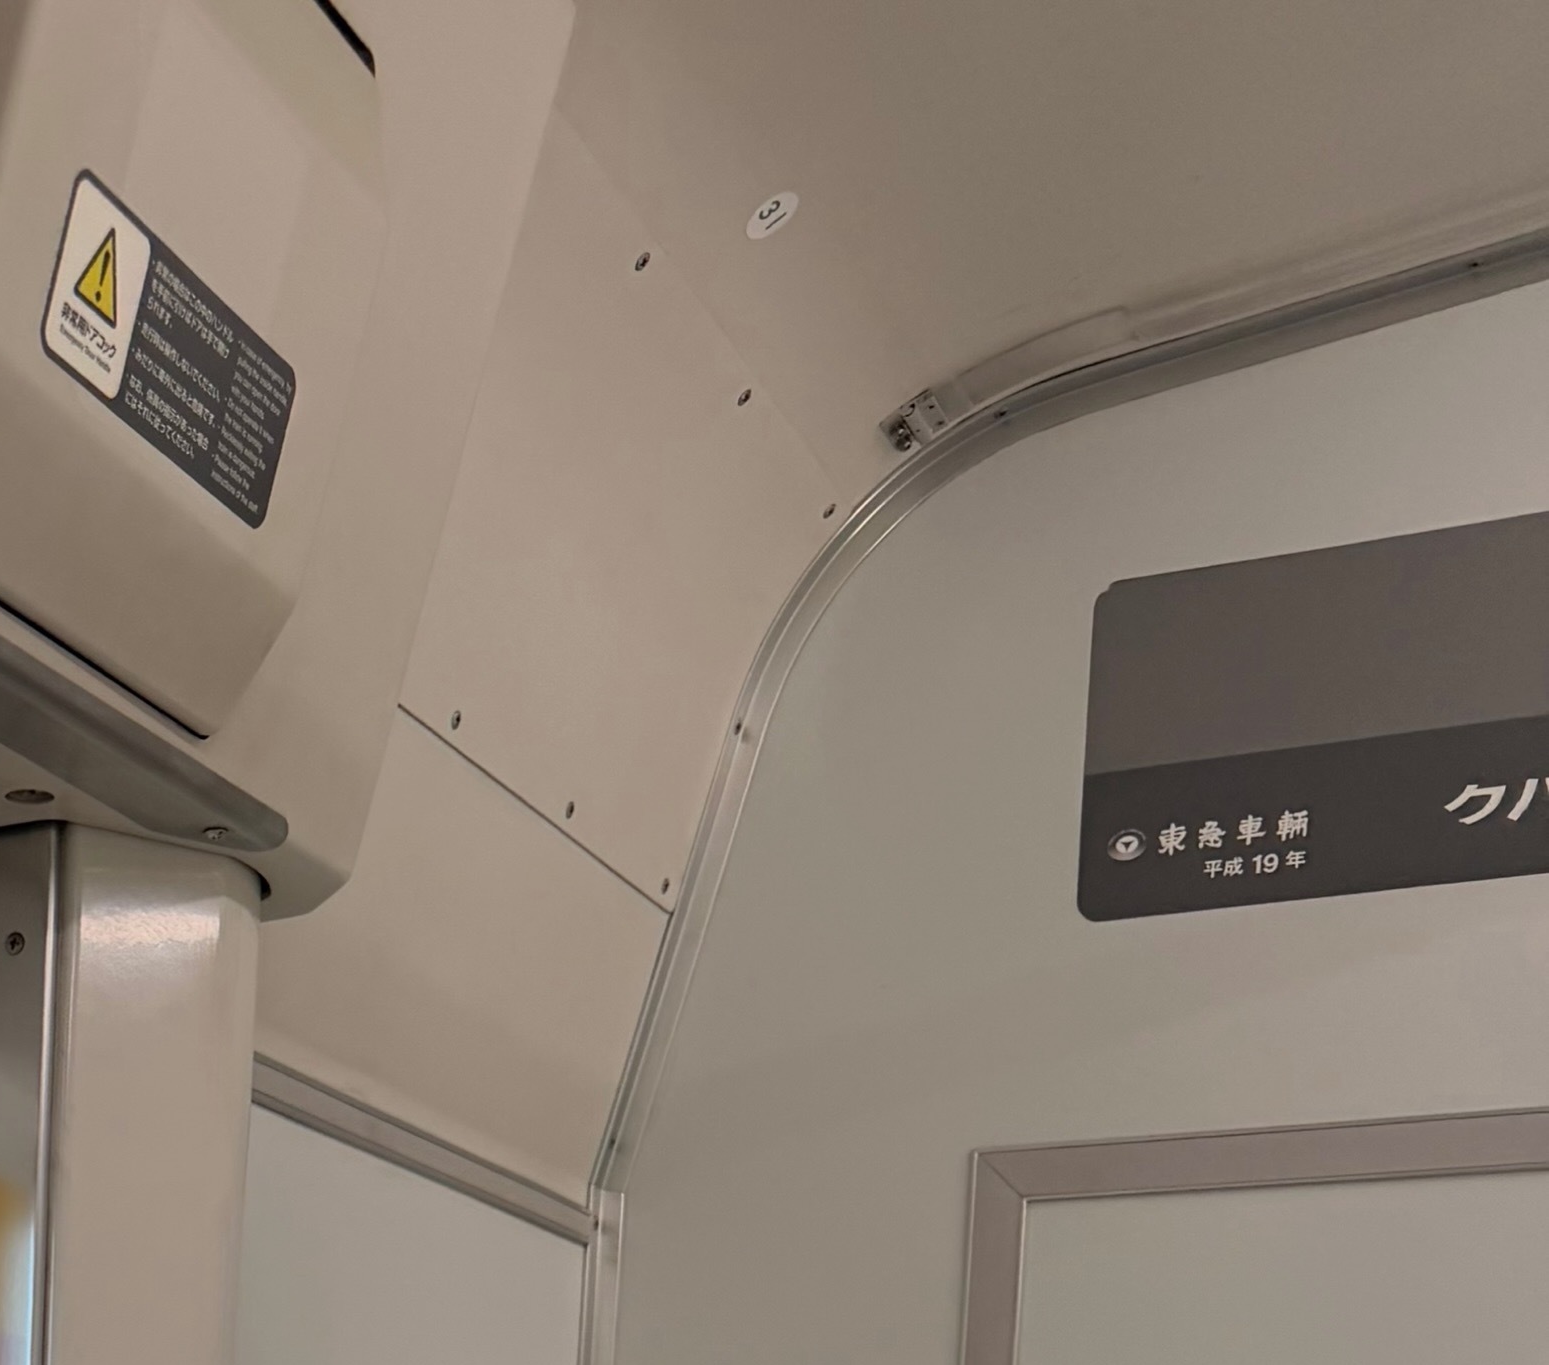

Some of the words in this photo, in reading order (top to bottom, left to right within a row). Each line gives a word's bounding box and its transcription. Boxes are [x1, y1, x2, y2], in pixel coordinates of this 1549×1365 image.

[60, 300, 117, 362] 非常用ドアコック
[1157, 809, 1310, 856] 東急車輛
